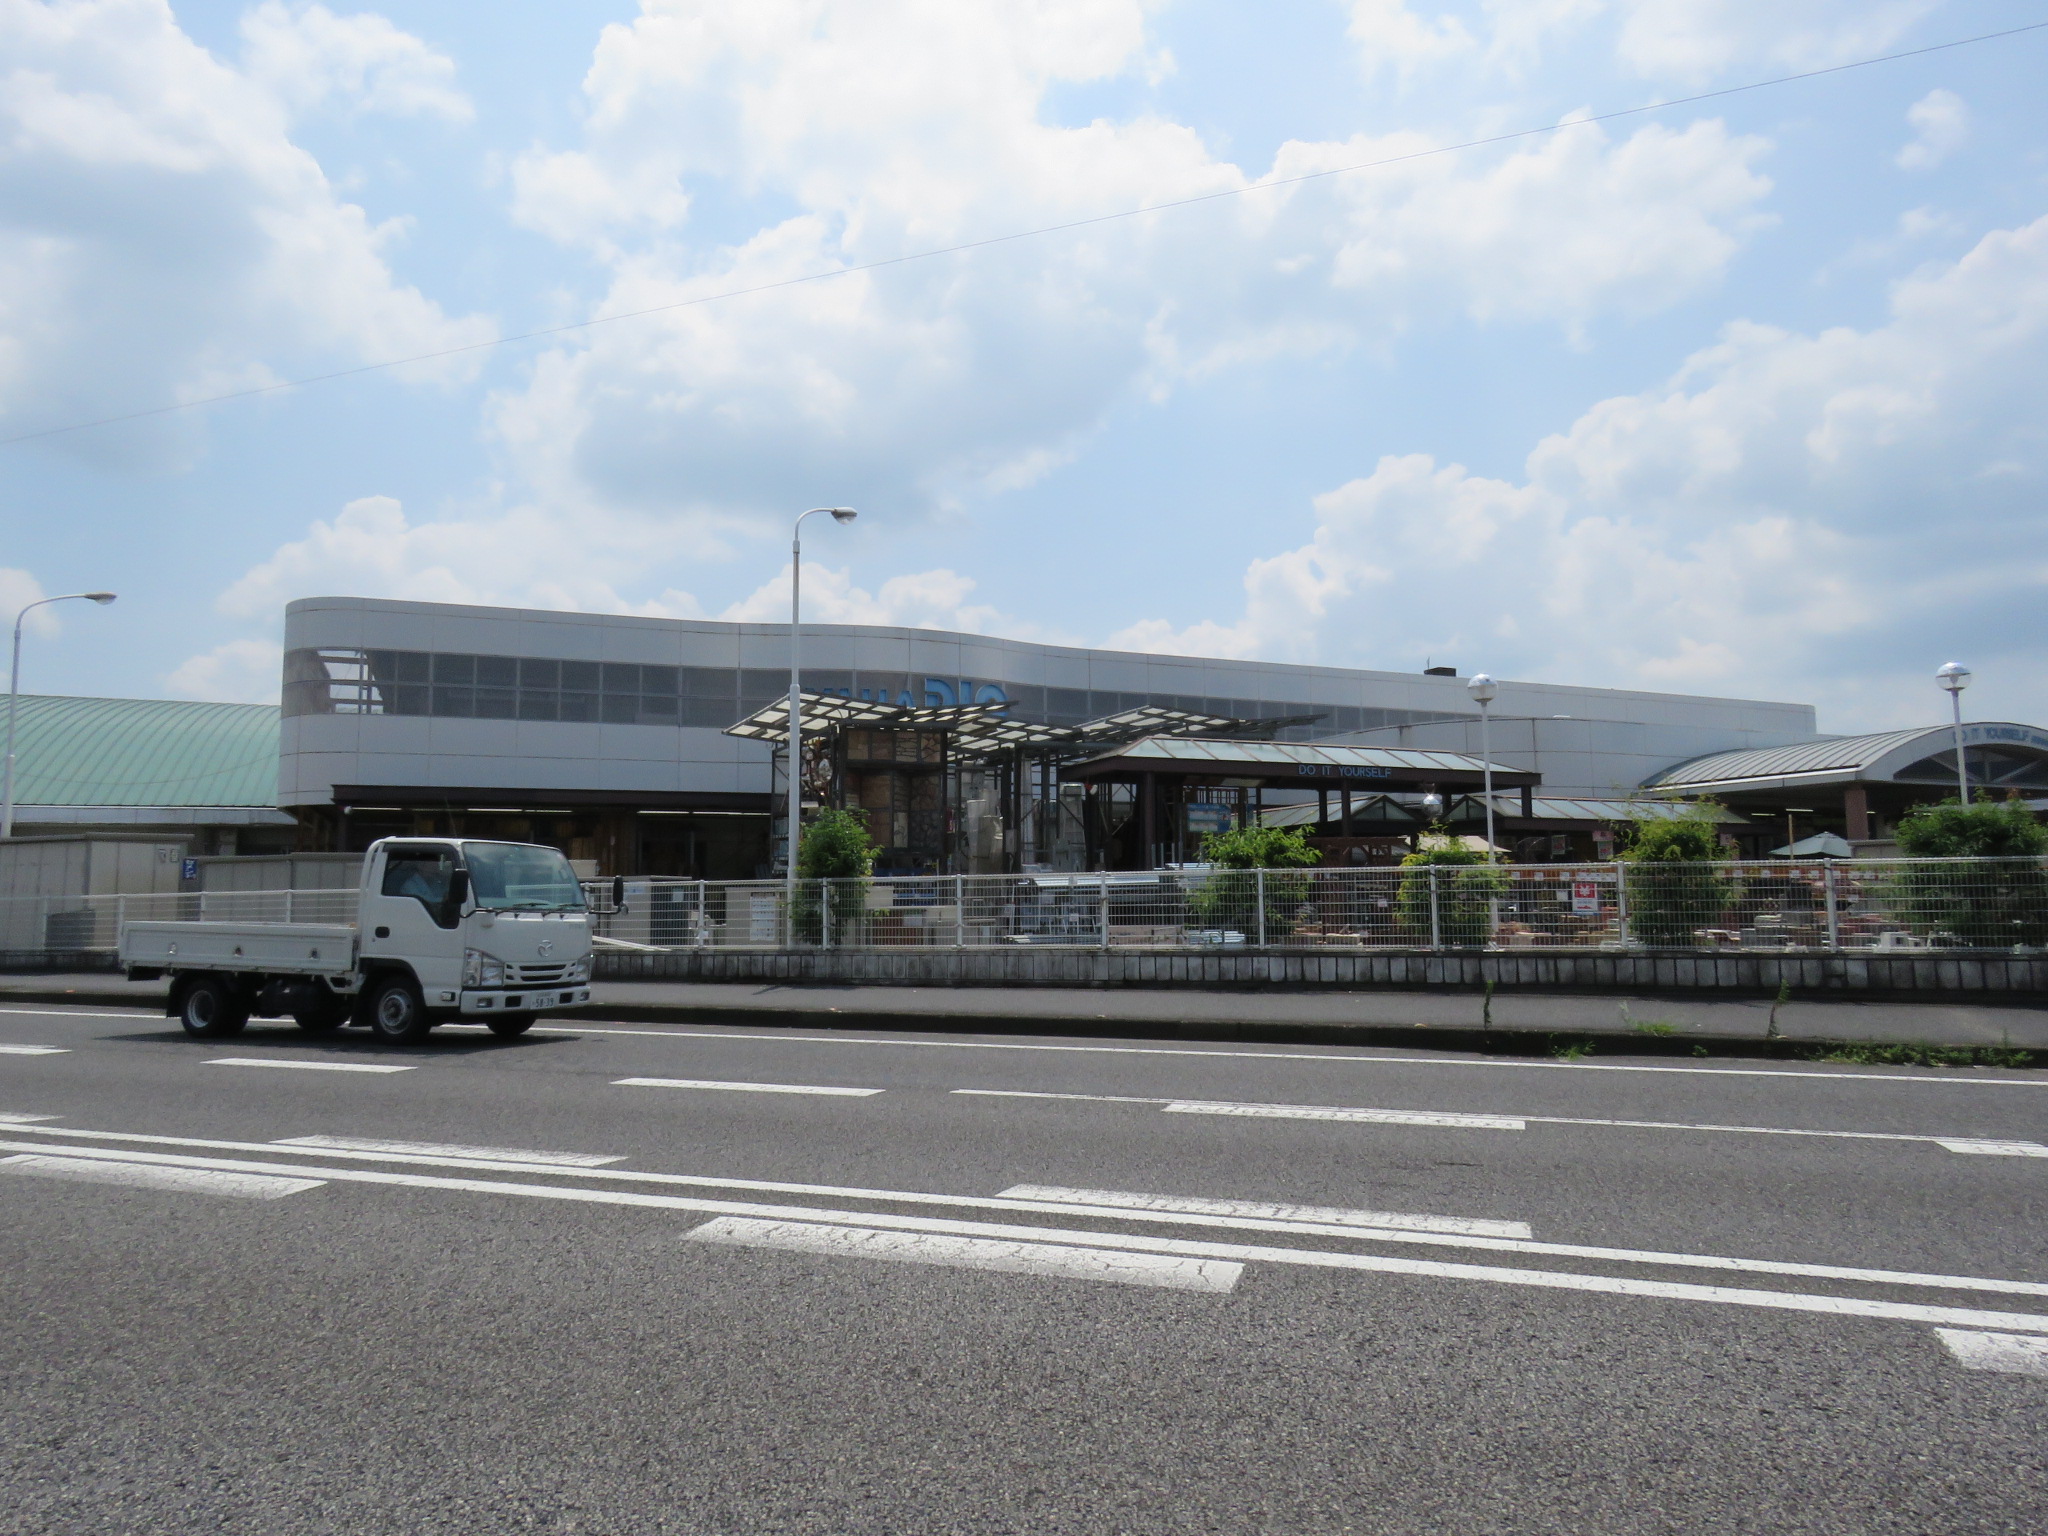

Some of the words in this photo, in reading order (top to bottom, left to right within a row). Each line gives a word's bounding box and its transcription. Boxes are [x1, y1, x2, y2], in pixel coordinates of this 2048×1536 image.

[1298, 764, 1316, 775] DO
[1321, 765, 1331, 776] IT
[1338, 766, 1392, 778] YOURSELF
